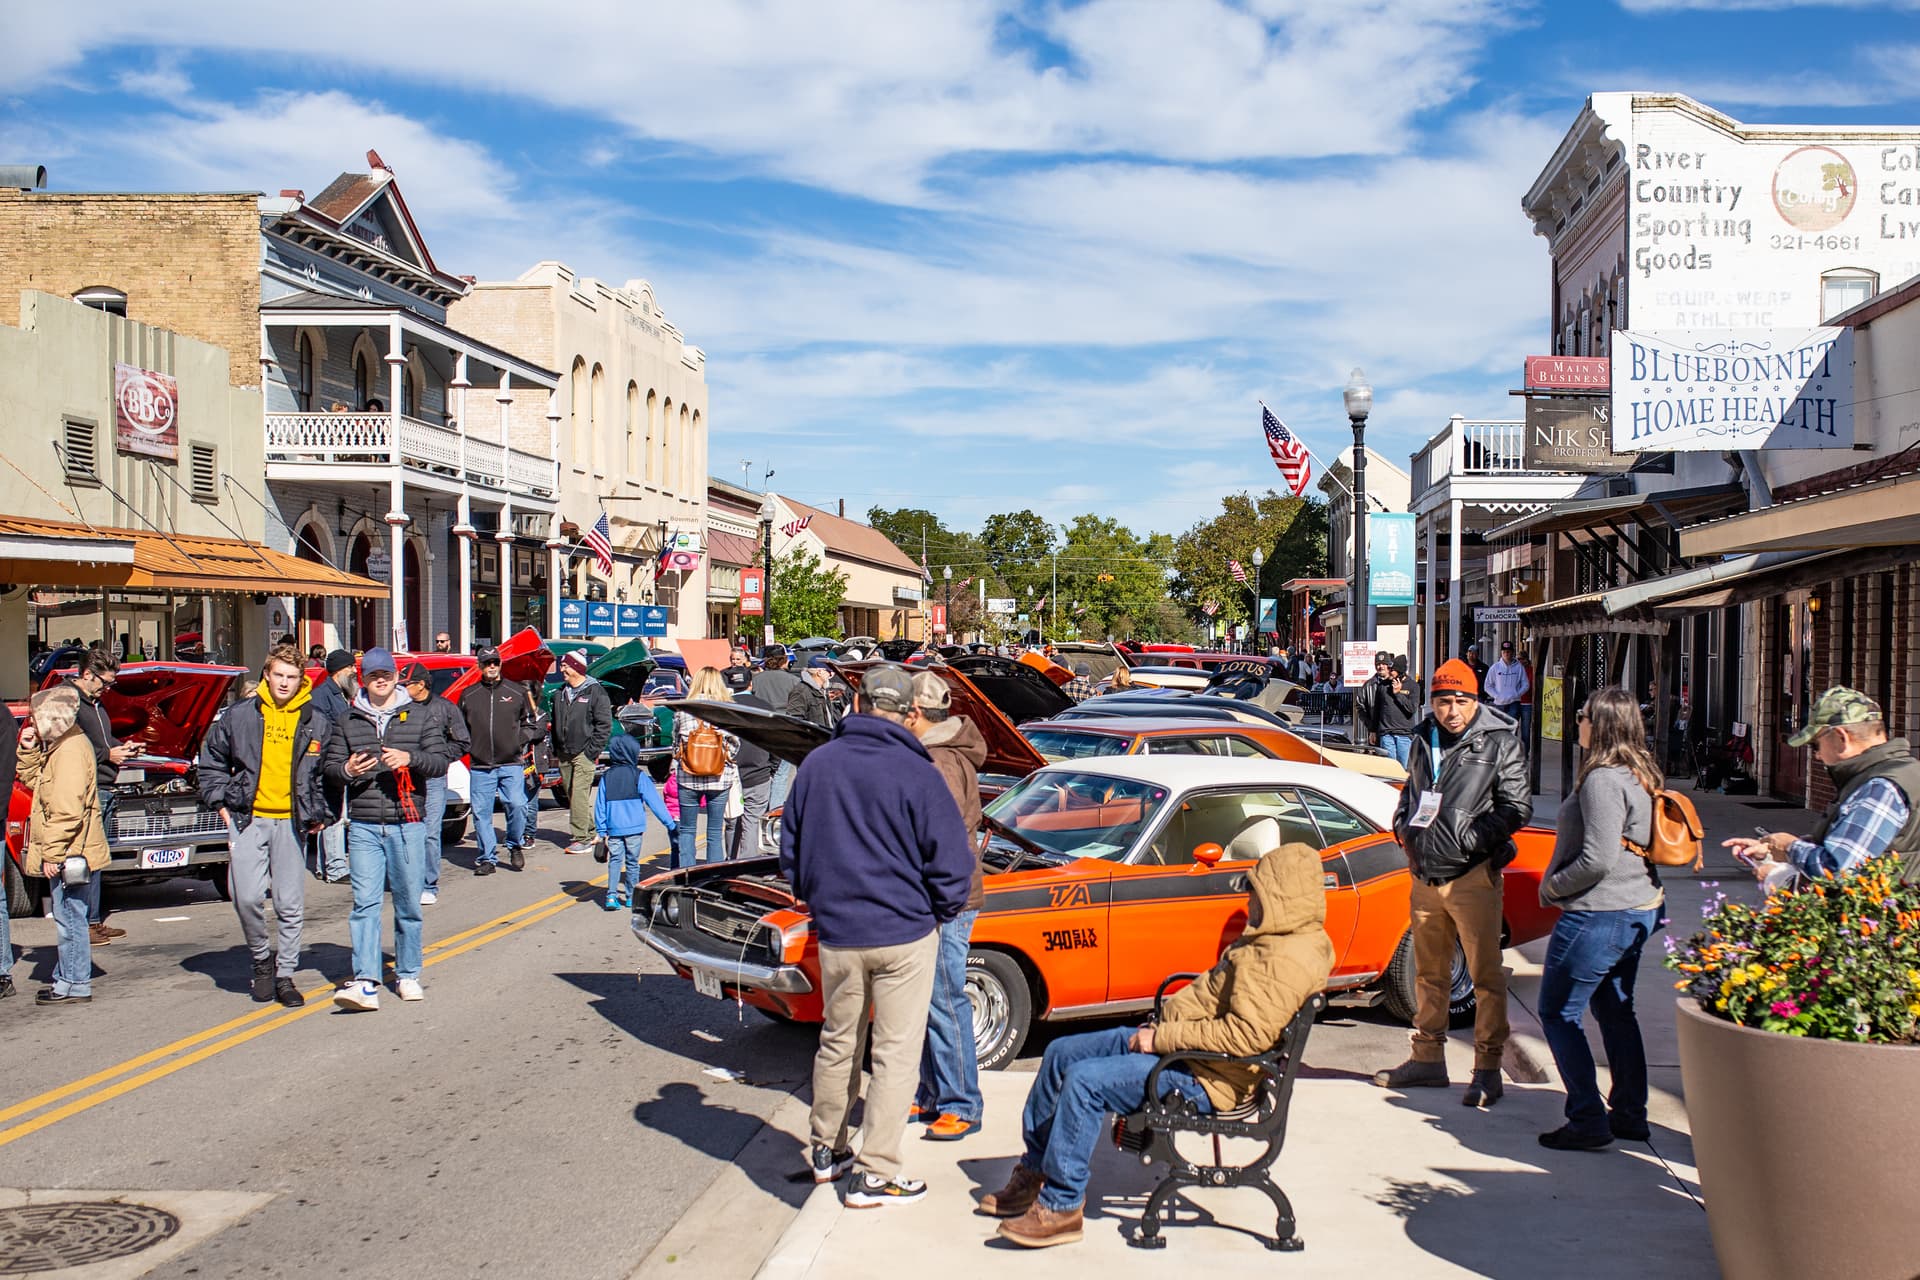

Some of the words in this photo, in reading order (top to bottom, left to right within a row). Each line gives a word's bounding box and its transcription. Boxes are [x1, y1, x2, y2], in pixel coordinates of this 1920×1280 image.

[1636, 144, 1707, 170] River
[1636, 179, 1742, 211] Country
[1636, 213, 1751, 244] Sporting
[1770, 235, 1860, 250] 321-4661
[1635, 245, 1712, 278] Goods
[1554, 361, 1589, 372] MAIN
[1598, 362, 1609, 372] S
[1630, 339, 1837, 382] BLUEBONNET
[1540, 371, 1607, 383] BUSINESS
[1631, 398, 1714, 440] HOME
[1722, 397, 1837, 437] HEALTH
[1535, 426, 1580, 446] NIK
[1554, 447, 1607, 457] PROPERTY
[1220, 661, 1266, 676] LOTUS
[152, 850, 181, 863] NHRA
[1049, 883, 1091, 907] T/A
[1042, 930, 1073, 951] 340
[1074, 938, 1098, 949] PAK
